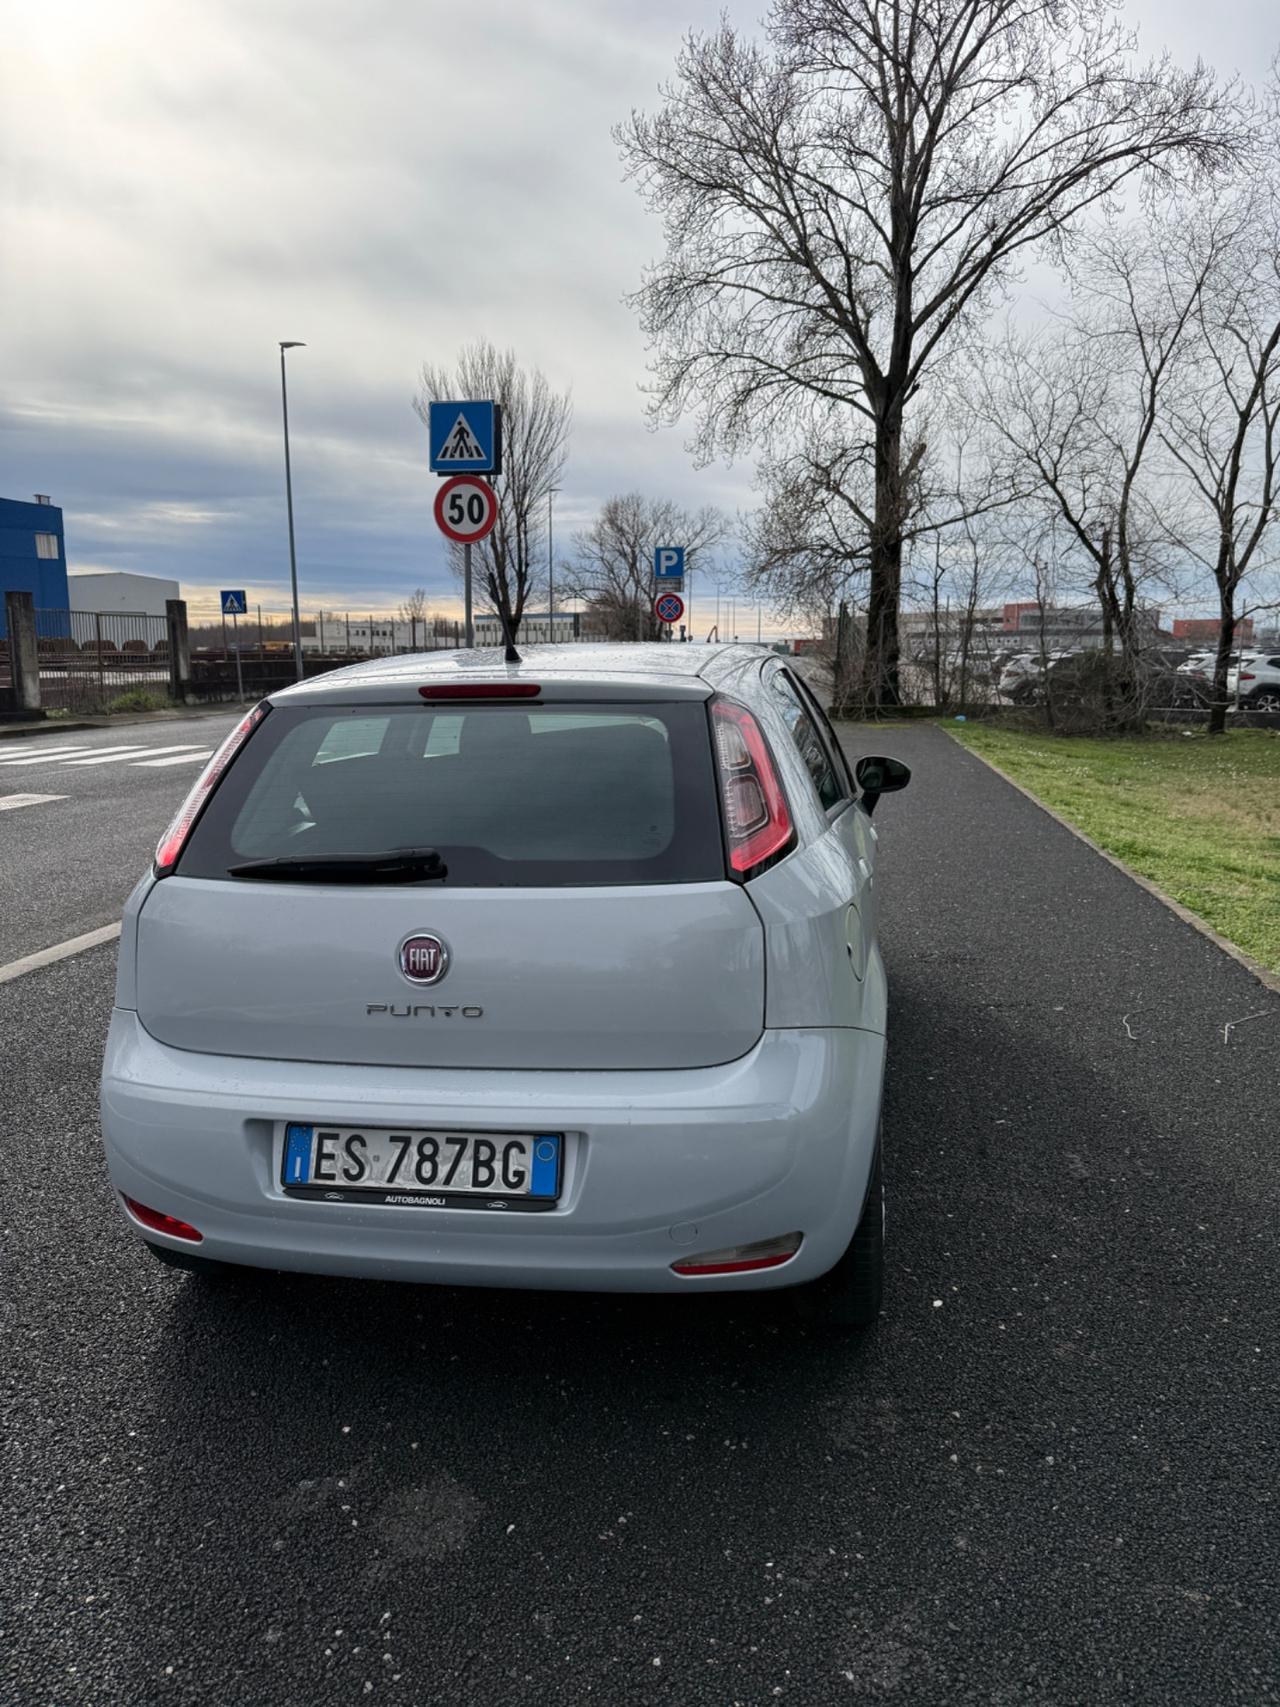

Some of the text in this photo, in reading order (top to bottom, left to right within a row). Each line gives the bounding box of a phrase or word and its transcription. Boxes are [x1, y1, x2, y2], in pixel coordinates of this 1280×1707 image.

[448, 493, 484, 525] 50
[660, 550, 679, 575] P
[409, 948, 437, 971] FIAT
[366, 1002, 484, 1018] PUNTO
[384, 1194, 446, 1206] AUTOBAGNOLI
